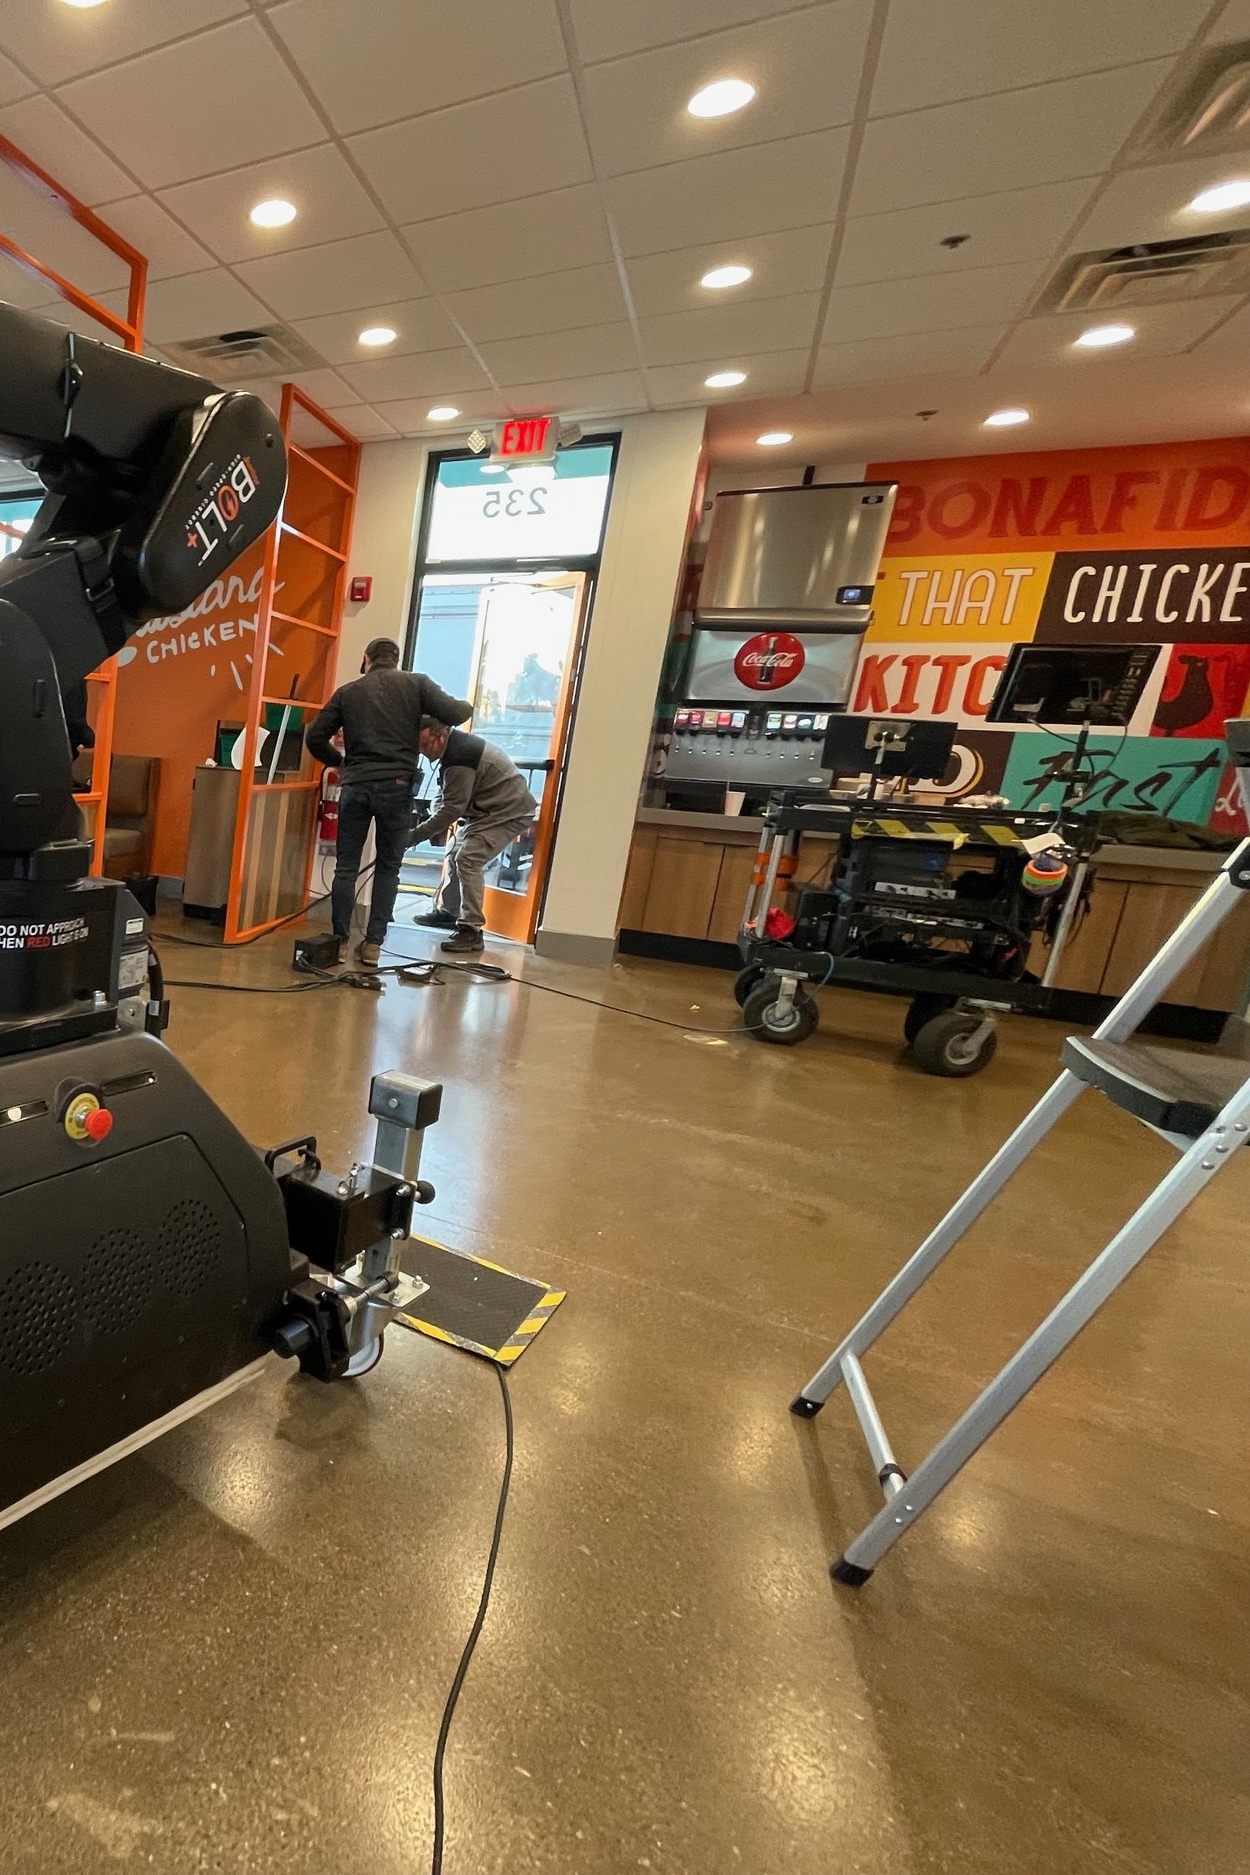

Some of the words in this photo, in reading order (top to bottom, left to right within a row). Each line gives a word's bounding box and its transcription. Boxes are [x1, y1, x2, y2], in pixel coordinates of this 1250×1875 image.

[501, 418, 551, 456] EXIT
[886, 466, 1250, 543] BONAFID
[897, 567, 1037, 627] THAT
[1063, 562, 1250, 624] CHICKE
[147, 613, 259, 664] CHICKEN
[853, 654, 1008, 716] KITC
[19, 924, 45, 937] NOT
[26, 936, 51, 949] RED
[52, 931, 74, 947] LIGHT
